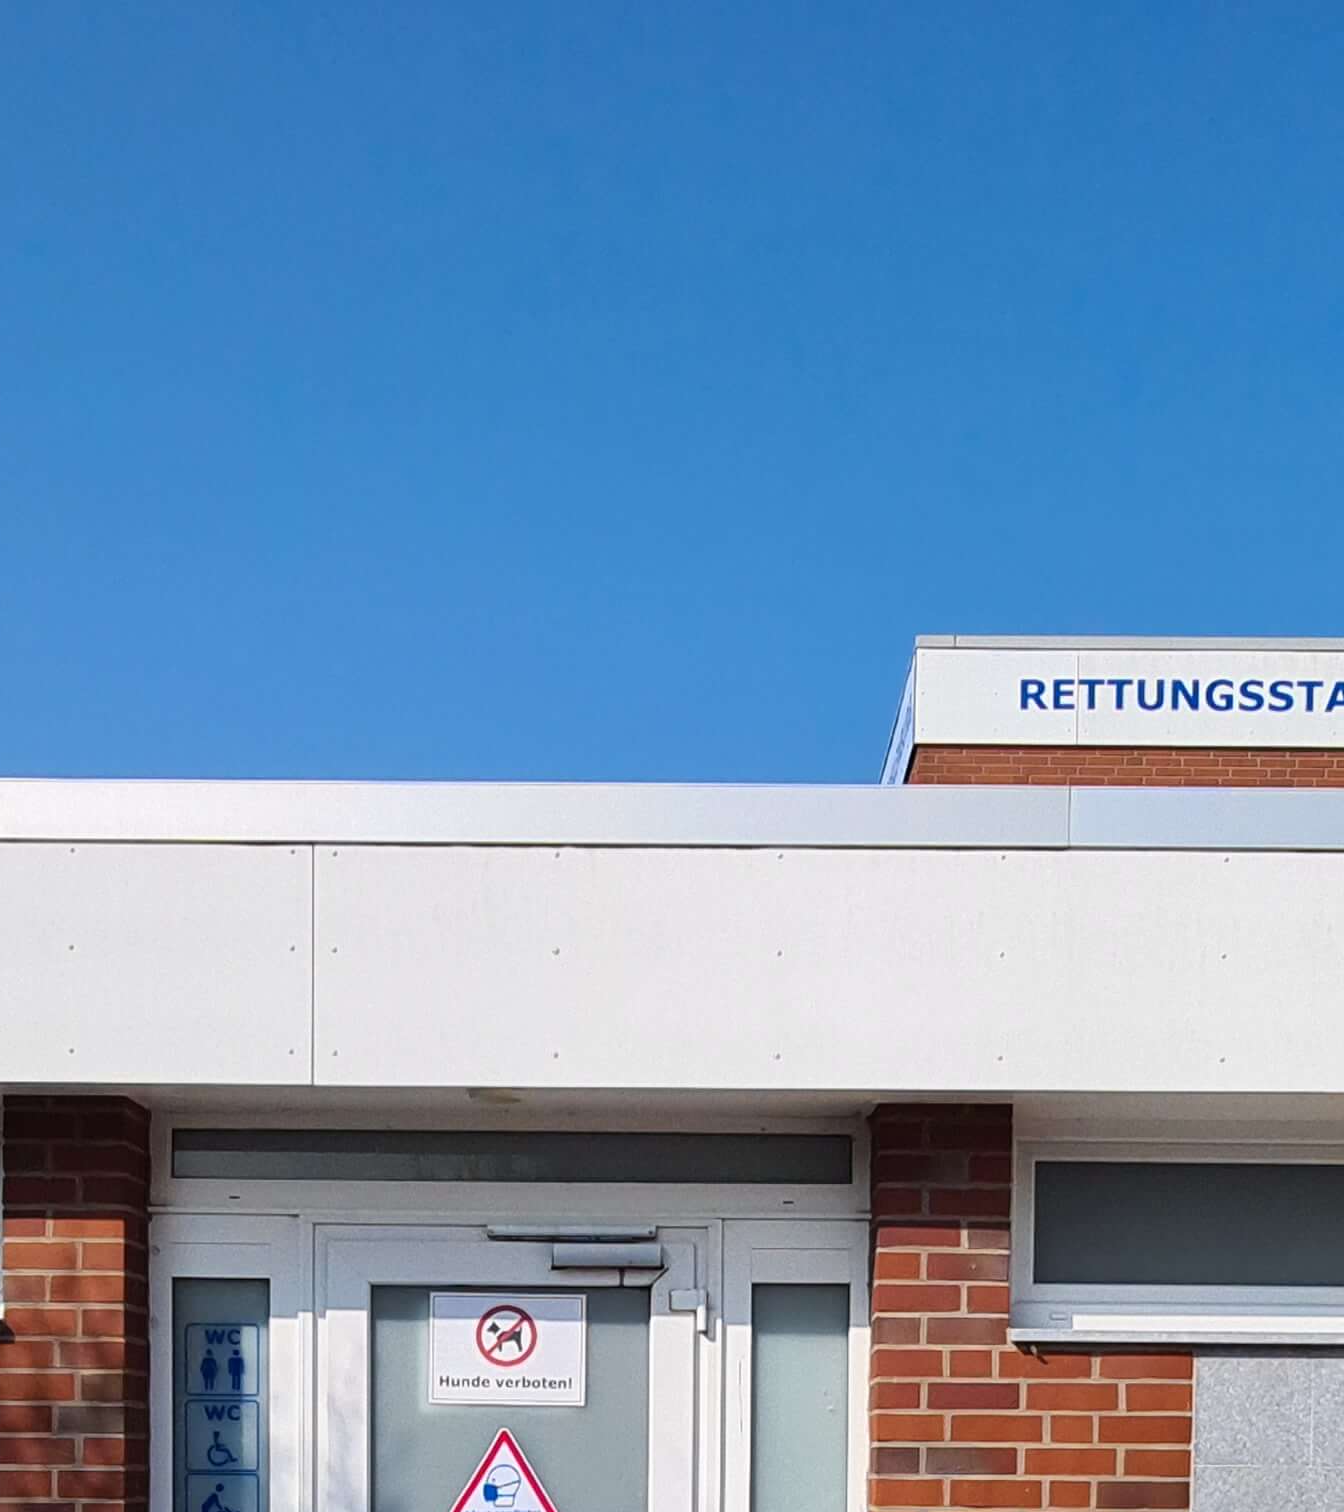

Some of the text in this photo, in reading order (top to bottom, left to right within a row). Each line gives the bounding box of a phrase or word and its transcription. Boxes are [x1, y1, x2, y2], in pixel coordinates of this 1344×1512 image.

[204, 1328, 241, 1345] WC
[439, 1375, 573, 1390] Hunde verboten!
[203, 1404, 241, 1421] WC
